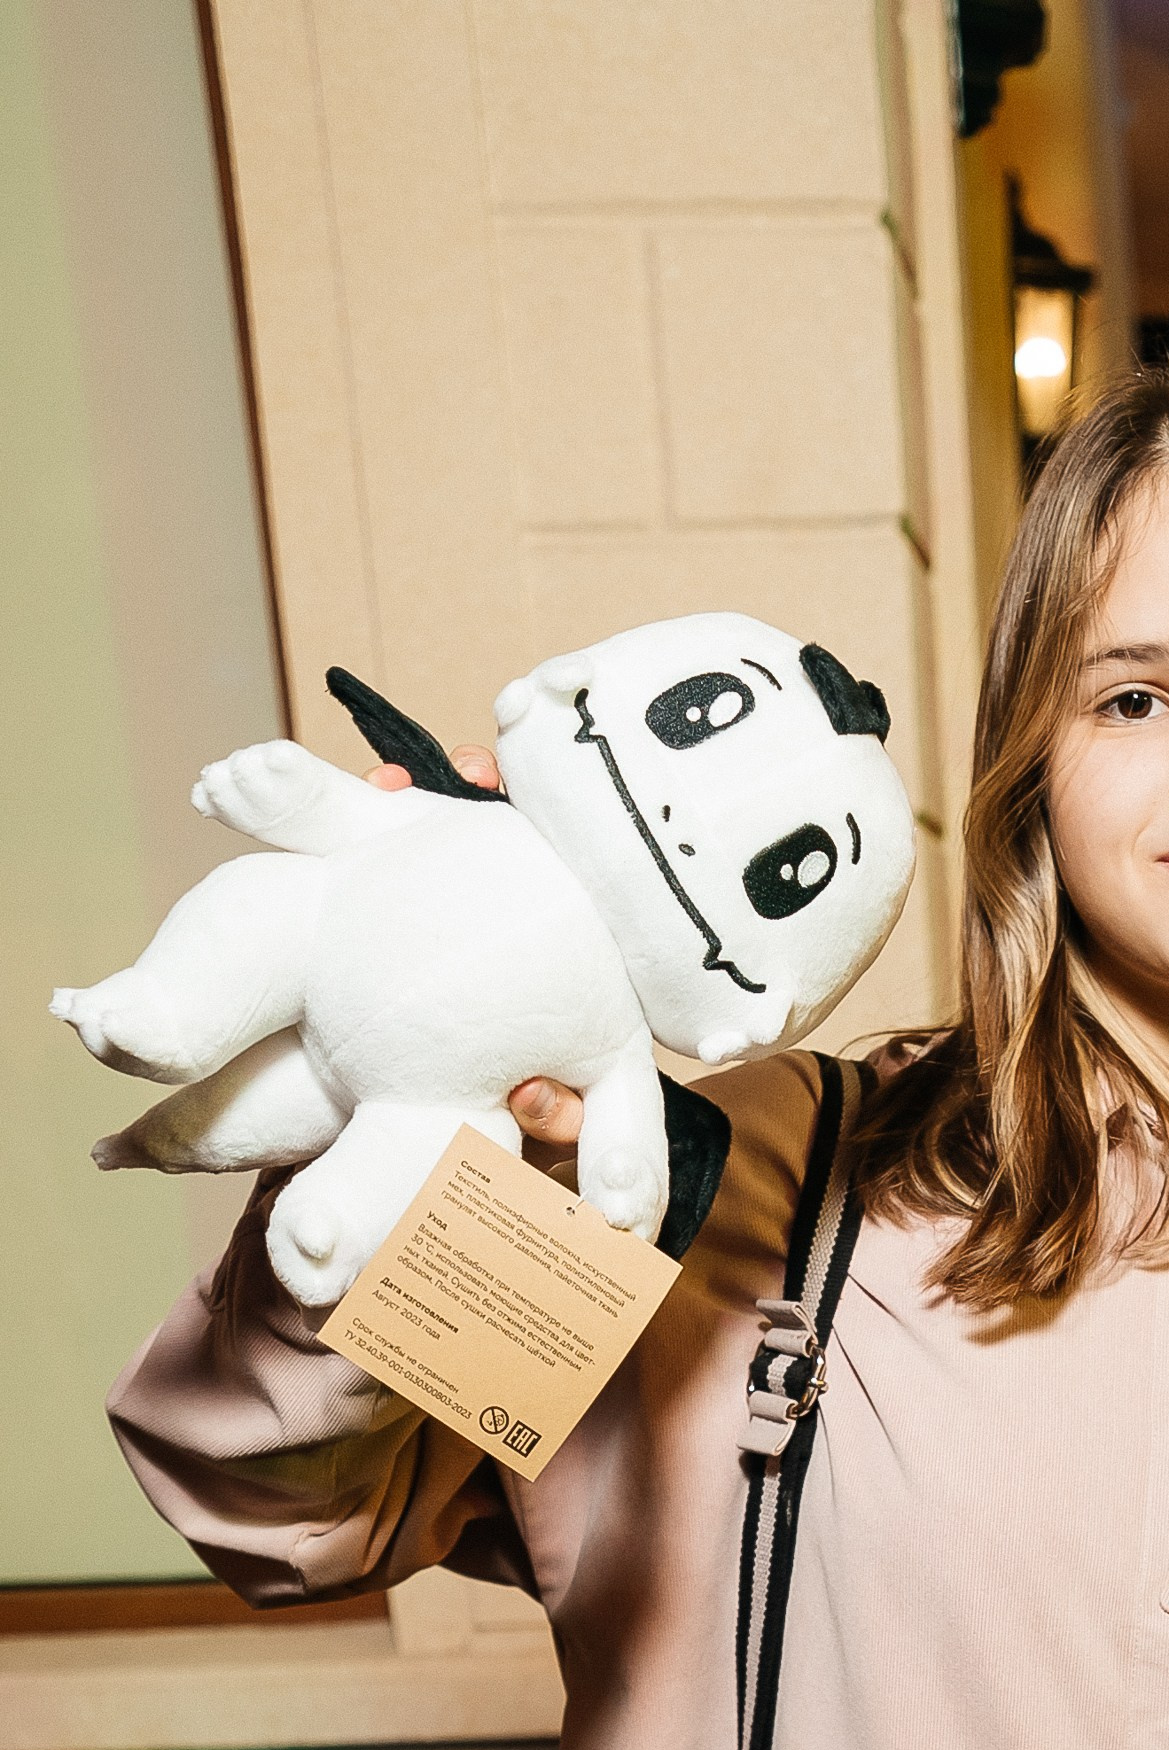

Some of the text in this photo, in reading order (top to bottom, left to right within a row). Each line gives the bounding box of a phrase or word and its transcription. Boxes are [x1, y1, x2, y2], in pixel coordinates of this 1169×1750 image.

[460, 1160, 490, 1183] Состав
[426, 1210, 447, 1231] Уход
[465, 1193, 515, 1230] пластиковая
[492, 1198, 548, 1239] полиэфирные
[440, 1190, 477, 1217] гранулят
[476, 1215, 514, 1243] высокого
[598, 1300, 618, 1318] ткань
[371, 1289, 440, 1340] Август 2023 года
[379, 1276, 458, 1333] Дата изготовления
[403, 1244, 420, 1259] ных
[450, 1276, 480, 1301] Сушить
[481, 1297, 496, 1312] без
[496, 1309, 526, 1333] отжима
[526, 1331, 581, 1371] естественным
[410, 1233, 423, 1245] 30
[435, 1252, 487, 1291] использовать
[488, 1289, 523, 1316] моющие
[523, 1314, 559, 1342] средства
[558, 1339, 574, 1352] для
[417, 1223, 594, 1351] Влажная обработка при температуре не выше
[434, 1279, 460, 1301] После
[460, 1299, 486, 1319] сушки
[484, 1316, 525, 1347] расчесать
[344, 1329, 356, 1340] ТУ
[352, 1317, 459, 1393] Срок службы не ограничен
